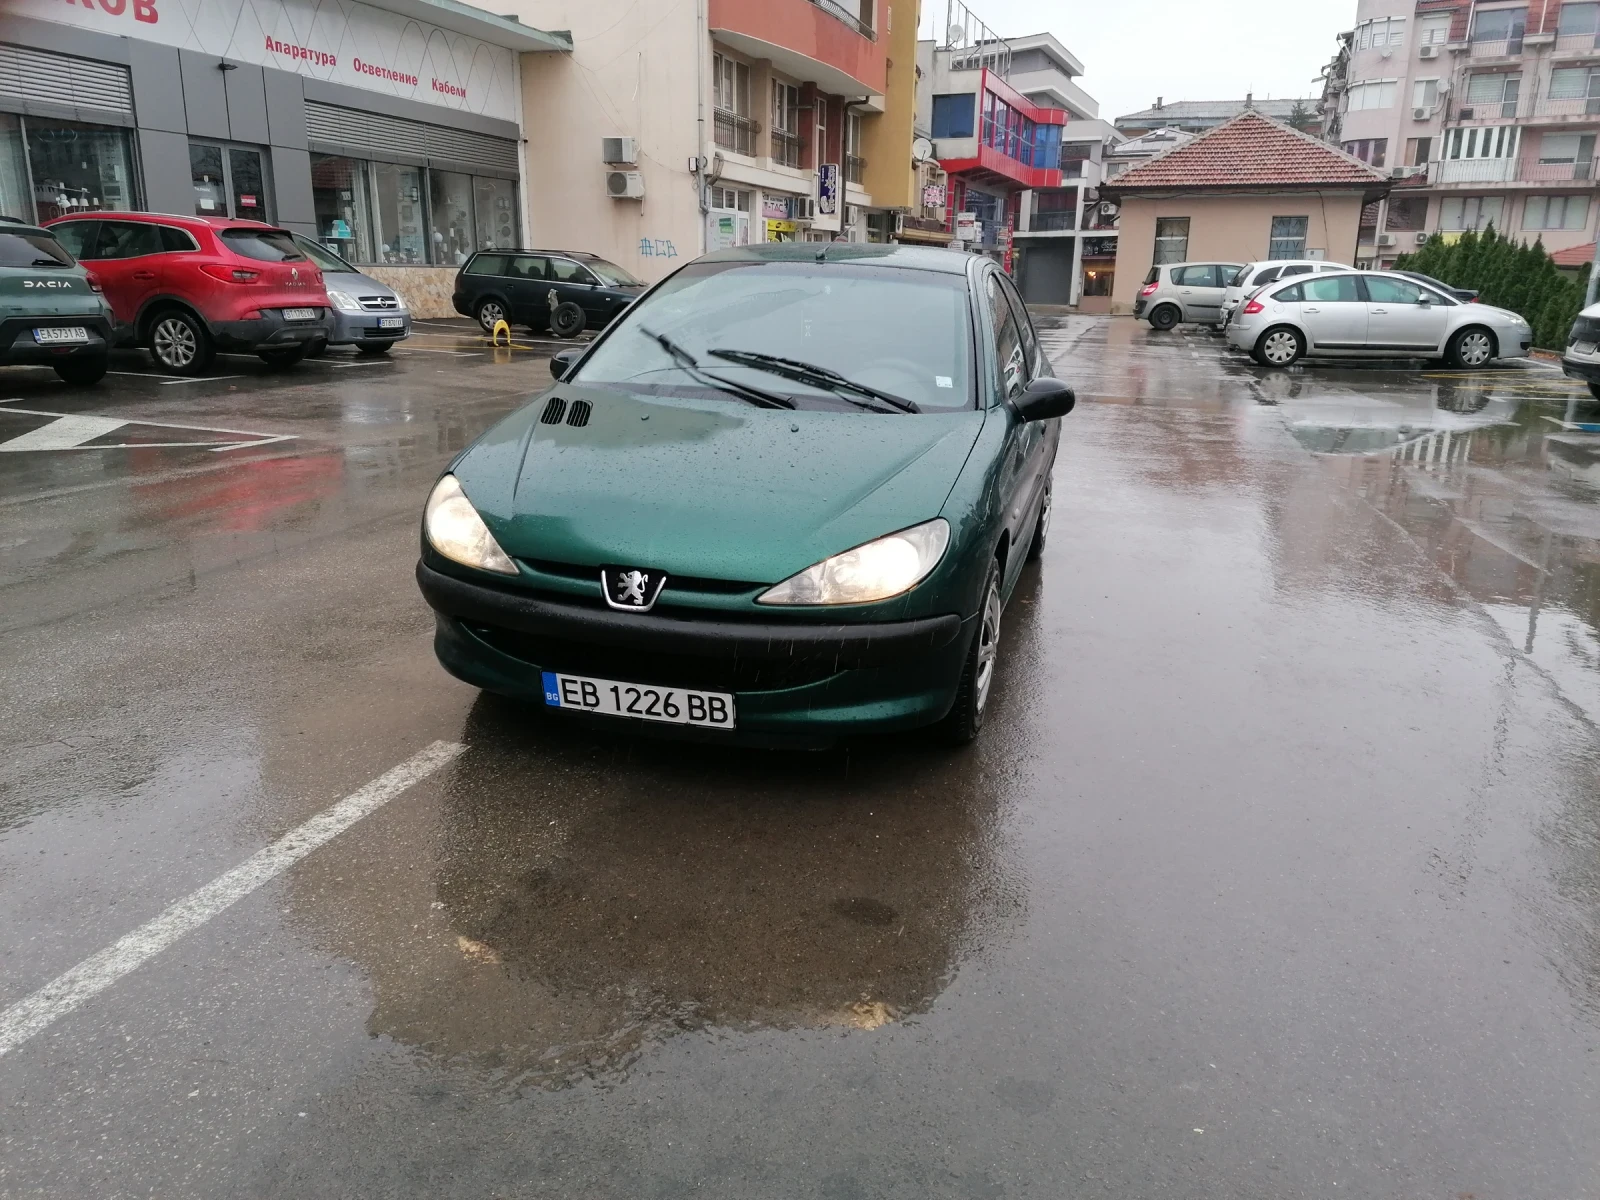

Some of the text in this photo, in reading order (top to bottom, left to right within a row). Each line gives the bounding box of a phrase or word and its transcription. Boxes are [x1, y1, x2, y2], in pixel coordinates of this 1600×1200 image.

[265, 35, 466, 98] Апаратура Осветление Кабели
[23, 280, 72, 288] DACIA
[546, 677, 729, 724] BG EB 1226 BB
